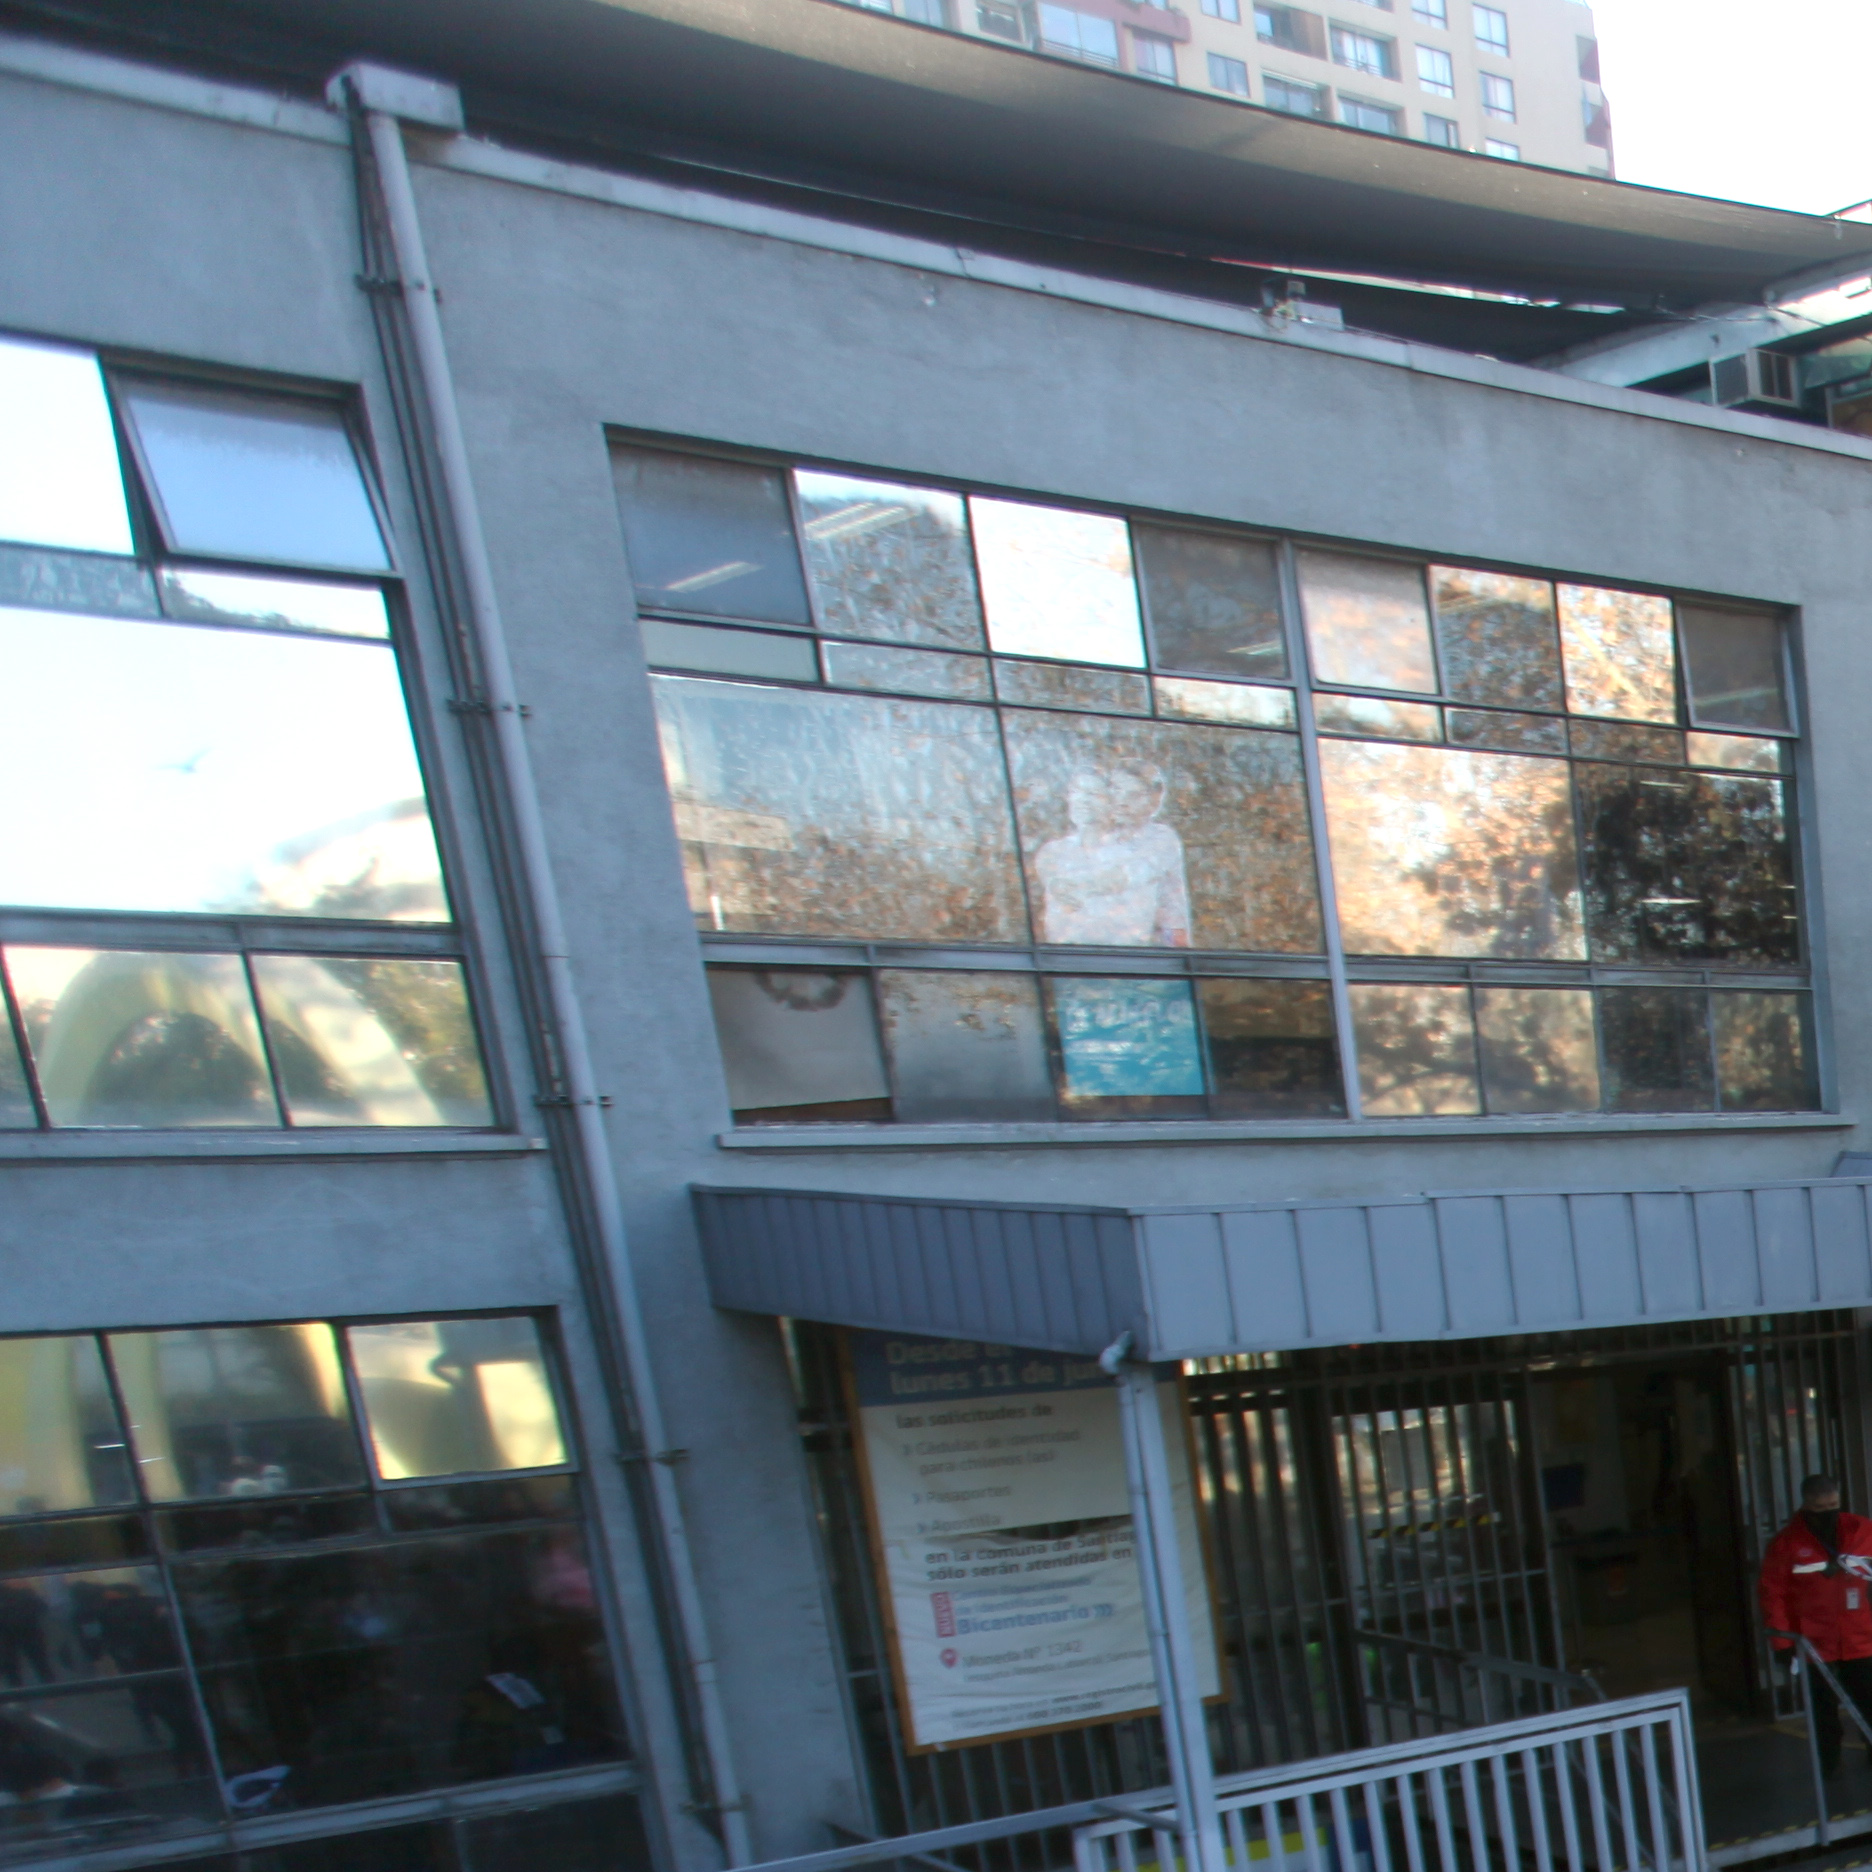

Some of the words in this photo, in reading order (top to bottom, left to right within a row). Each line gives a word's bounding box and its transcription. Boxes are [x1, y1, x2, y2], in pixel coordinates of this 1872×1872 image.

[885, 1339, 976, 1365] Desde
[889, 1369, 971, 1395] lunes
[979, 1364, 1013, 1388] 11
[1020, 1360, 1056, 1384] de
[1061, 1358, 1104, 1386] jun
[896, 1413, 923, 1430] las
[927, 1407, 1028, 1427] solicitudes
[1030, 1403, 1054, 1417] de
[925, 1551, 948, 1564] en
[953, 1548, 971, 1562] la
[975, 1542, 1047, 1560] comuna
[1051, 1538, 1073, 1552] de
[1077, 1531, 1138, 1549] Santiag
[926, 1566, 966, 1582] sólo
[970, 1560, 1020, 1577] serán
[1024, 1551, 1108, 1573] atendidas
[1111, 1547, 1133, 1561] en
[957, 1604, 1089, 1635] Bicentenario
[1046, 1639, 1083, 1657] 1342
